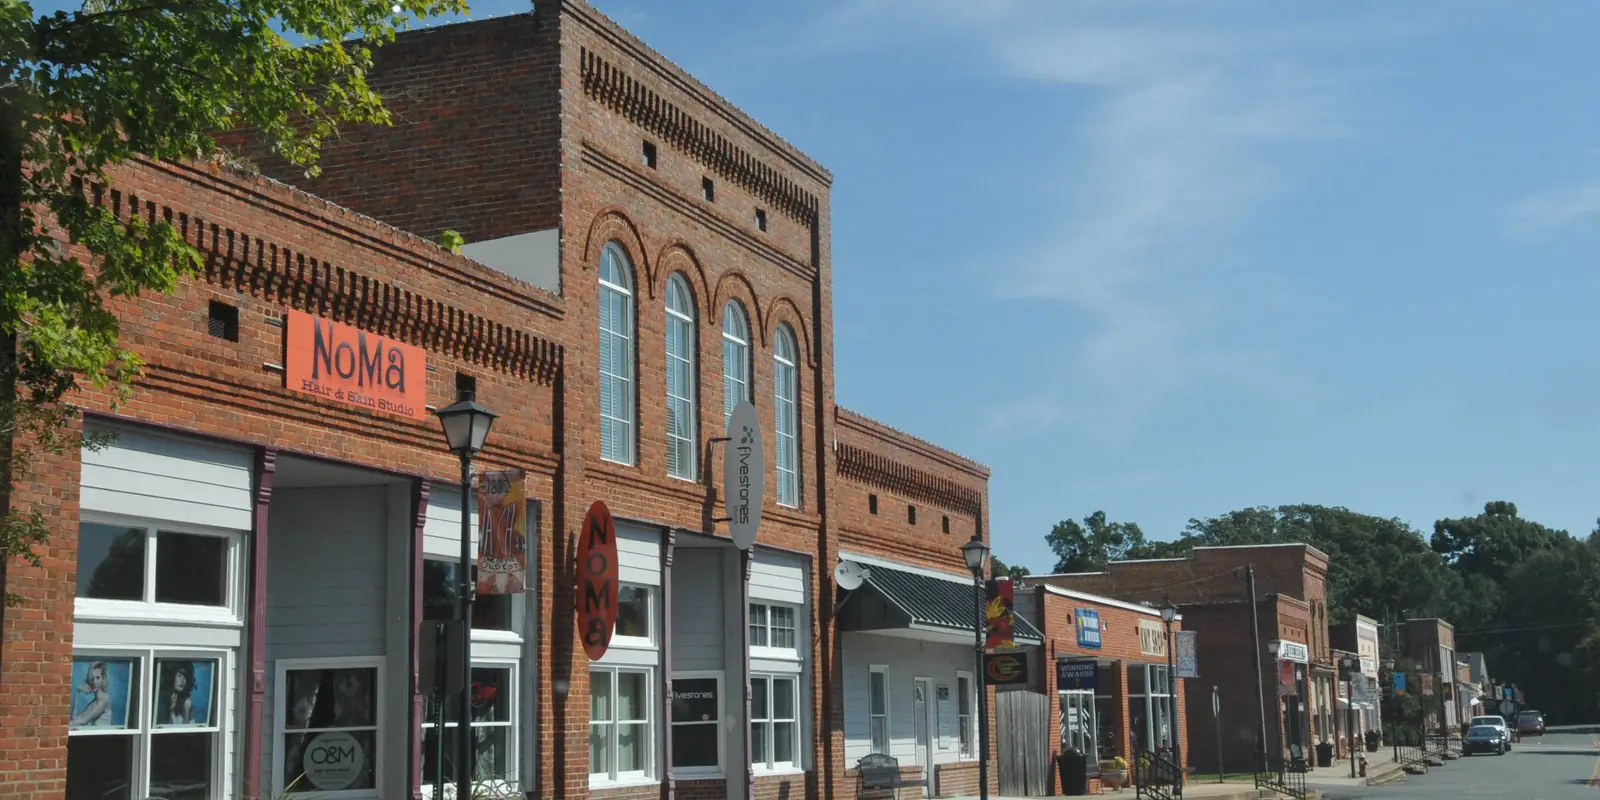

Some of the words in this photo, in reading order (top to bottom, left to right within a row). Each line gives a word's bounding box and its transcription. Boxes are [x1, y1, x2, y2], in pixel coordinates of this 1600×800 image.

[312, 316, 405, 393] NoMa
[301, 379, 332, 397] Hair
[335, 387, 344, 400] &
[347, 391, 375, 407] Skin
[378, 399, 414, 417] Studio
[311, 745, 355, 765] O&M
